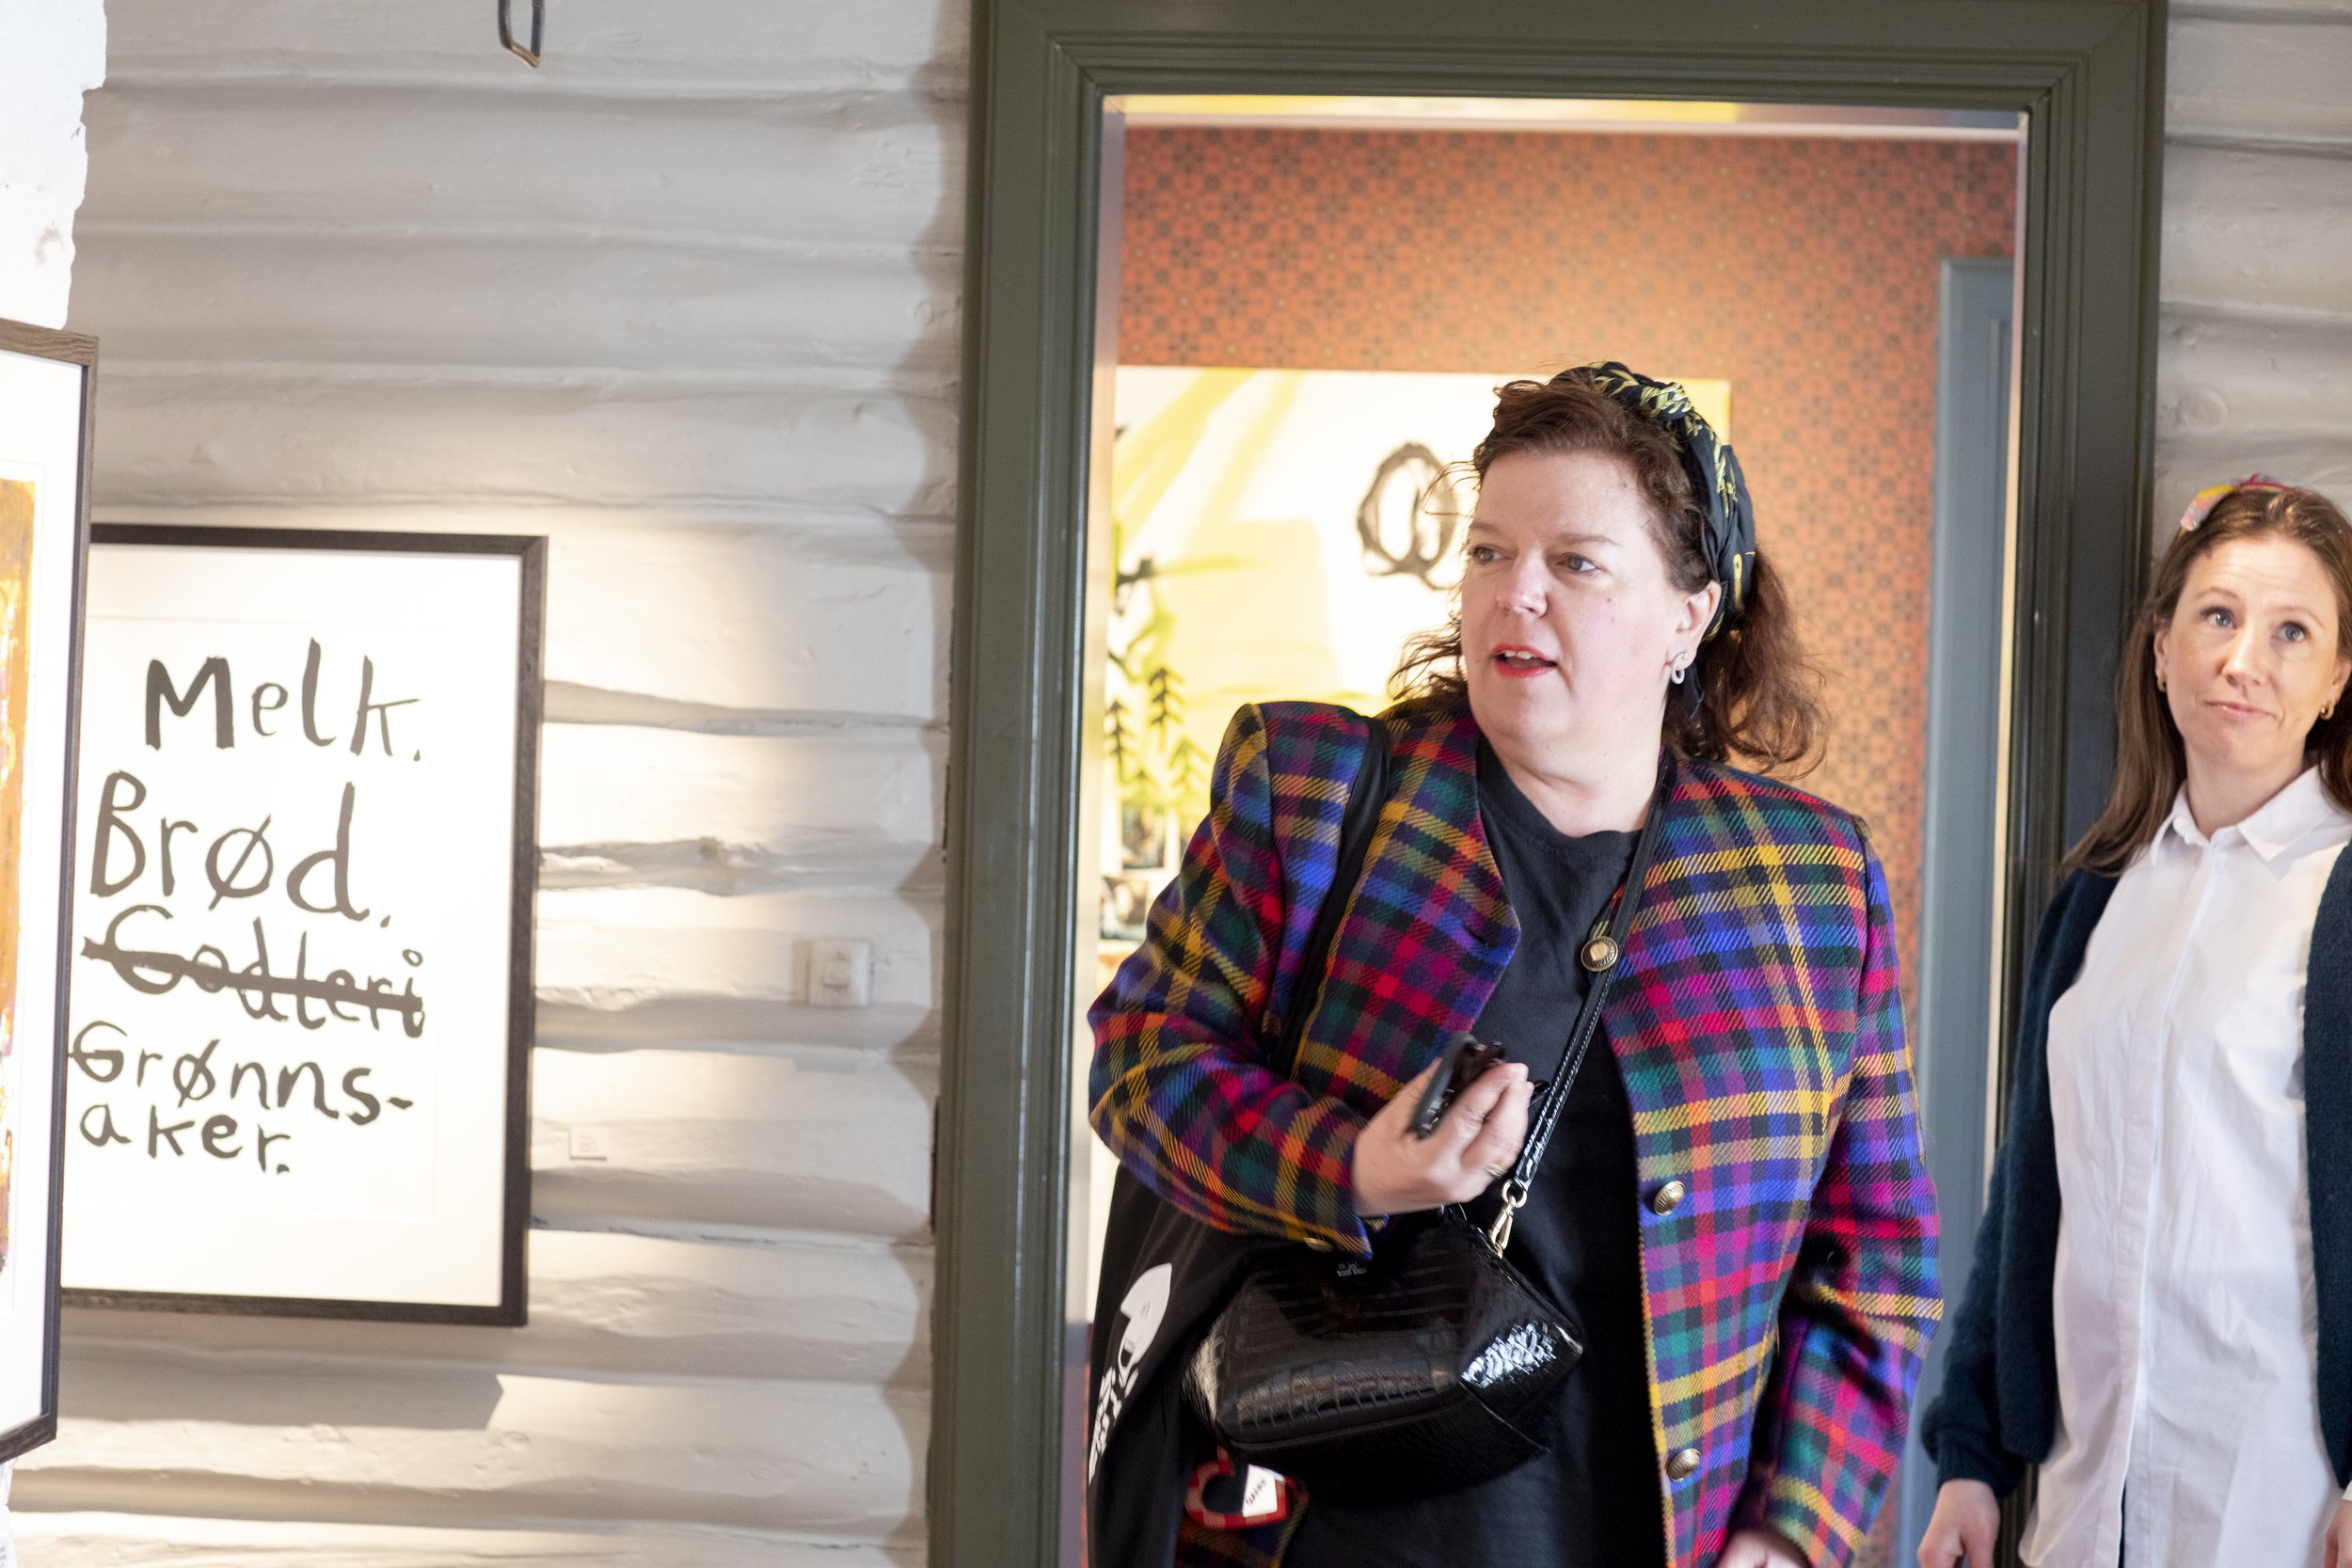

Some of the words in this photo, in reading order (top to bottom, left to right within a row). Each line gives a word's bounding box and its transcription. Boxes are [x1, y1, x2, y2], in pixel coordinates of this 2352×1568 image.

[145, 637, 422, 762] Melk.
[68, 1020, 415, 1125] Grønns-
[79, 1102, 292, 1175] aker.
